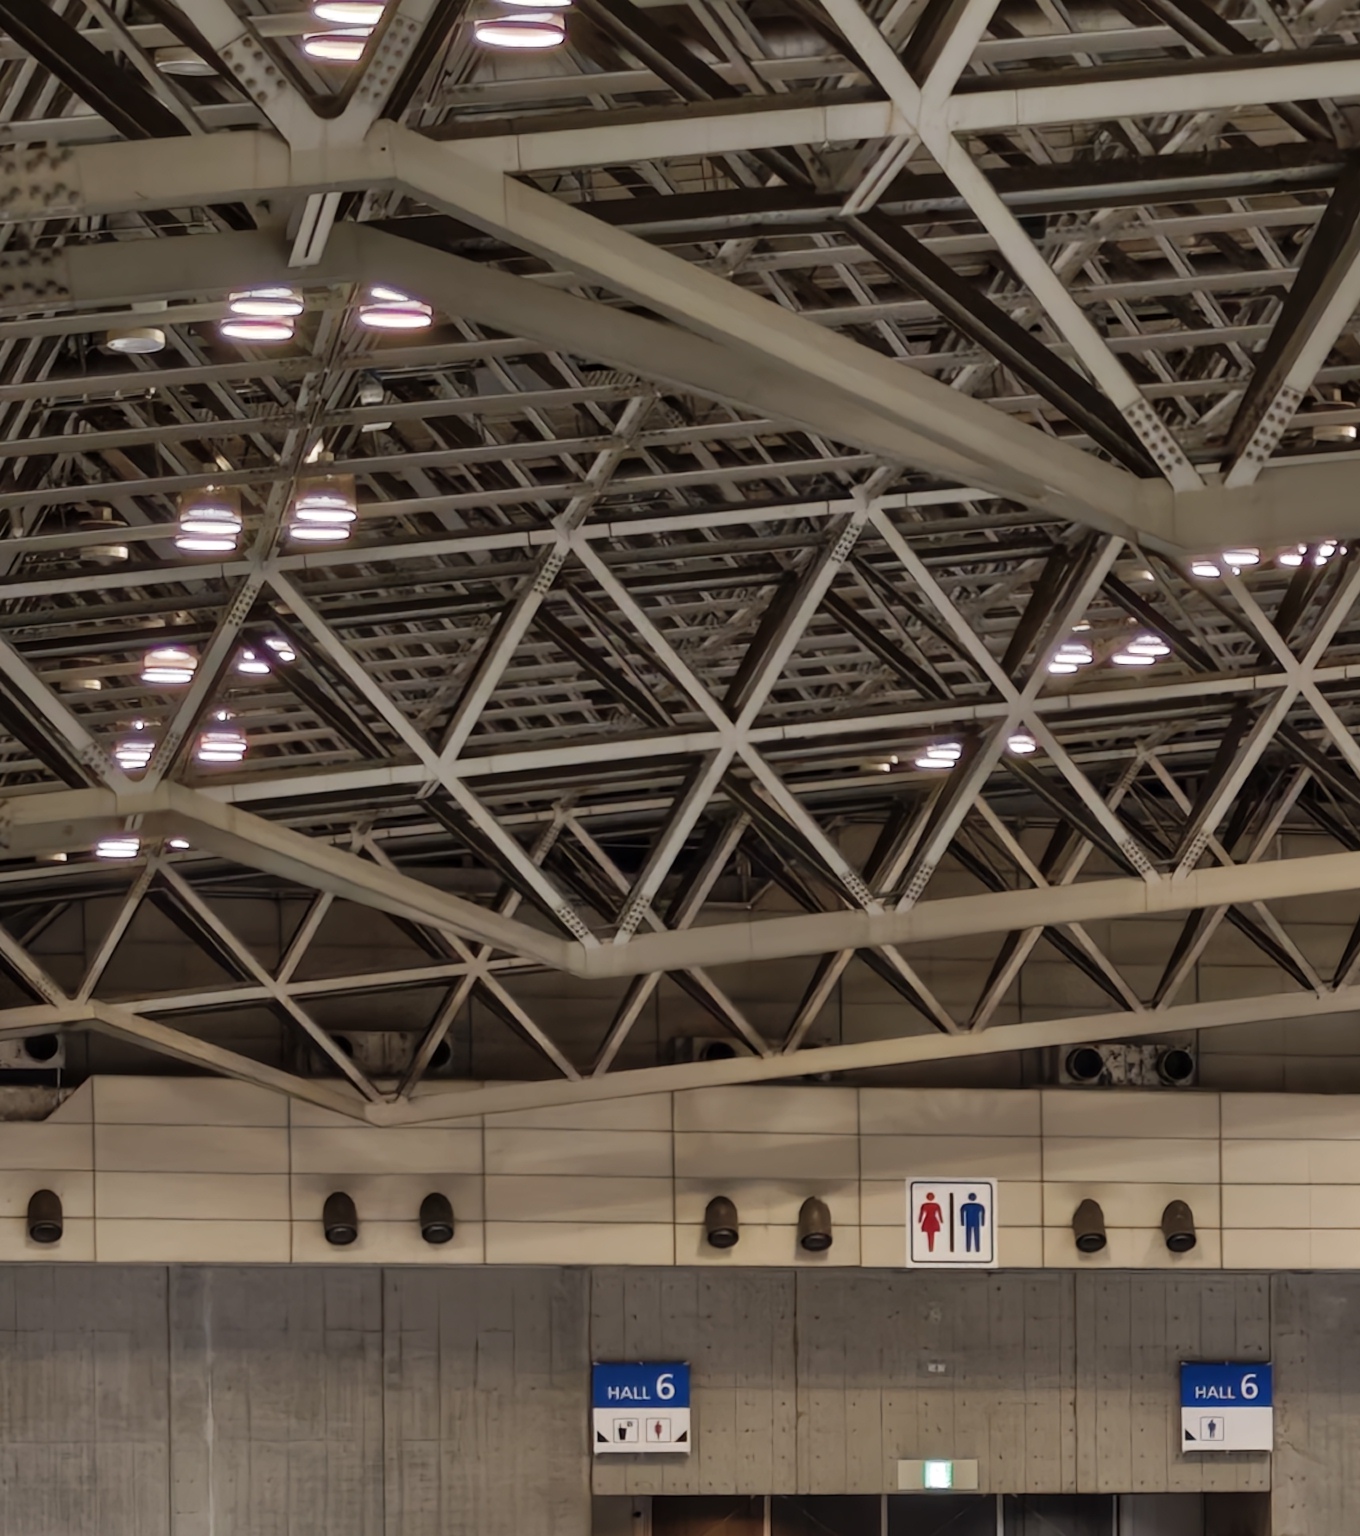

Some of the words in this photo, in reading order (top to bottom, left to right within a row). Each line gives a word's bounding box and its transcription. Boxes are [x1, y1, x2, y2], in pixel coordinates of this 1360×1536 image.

[607, 1385, 651, 1400] HALL
[656, 1374, 676, 1400] 6
[1195, 1385, 1237, 1400] HALL
[1240, 1374, 1259, 1400] 6
